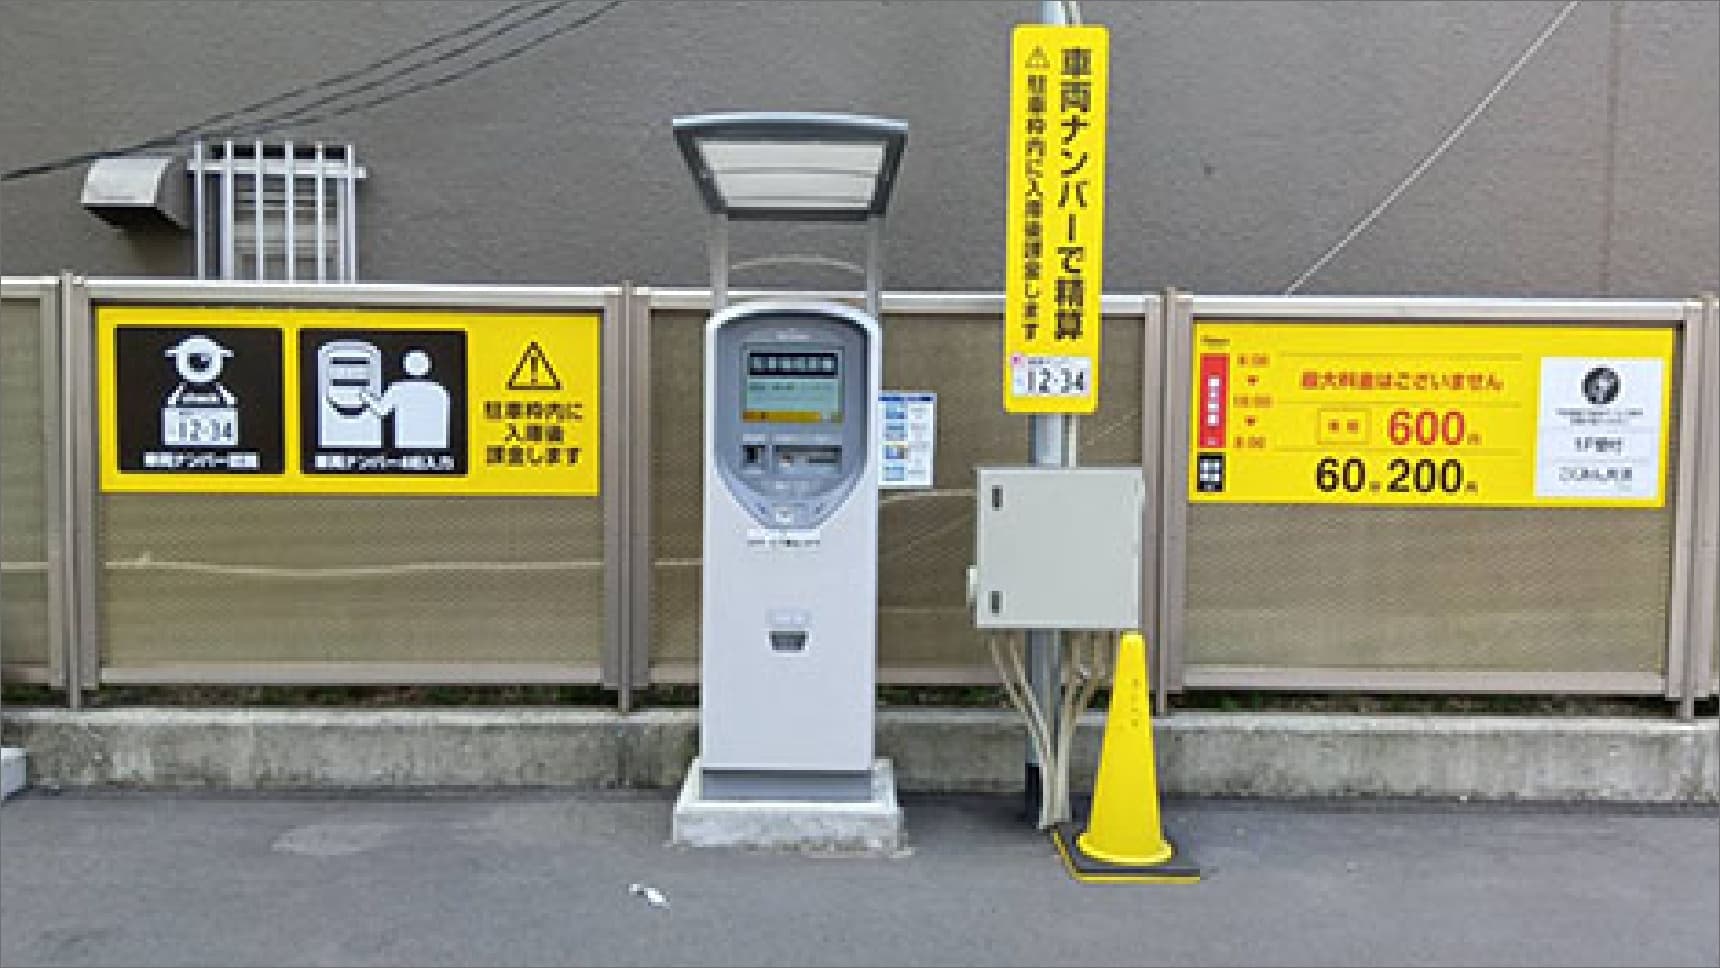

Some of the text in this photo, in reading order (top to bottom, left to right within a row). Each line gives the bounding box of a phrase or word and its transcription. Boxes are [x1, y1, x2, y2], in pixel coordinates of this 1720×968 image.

[1054, 46, 1093, 341] 車両ナンバーで精算
[482, 401, 584, 422] 駐車枠内に
[504, 423, 565, 444] 入庫後
[483, 445, 583, 467] 課金します
